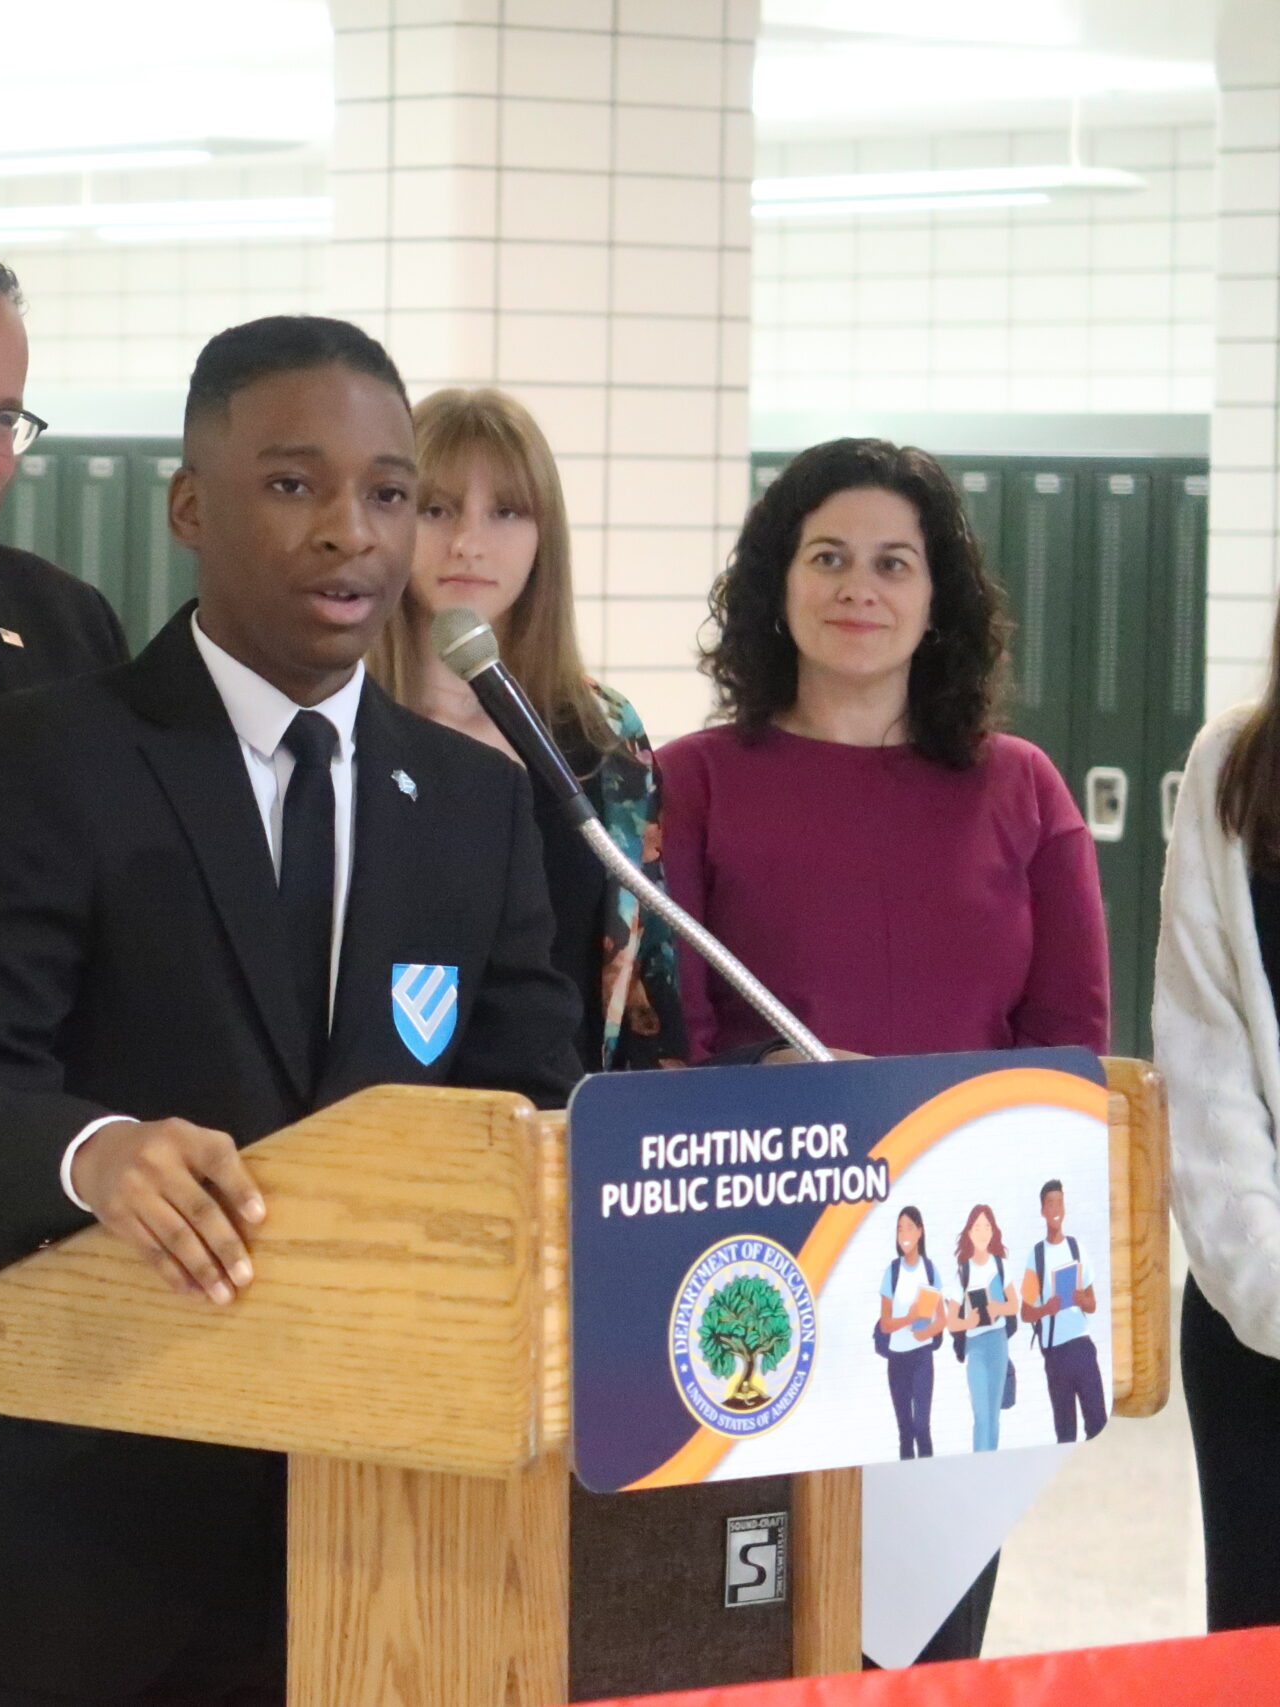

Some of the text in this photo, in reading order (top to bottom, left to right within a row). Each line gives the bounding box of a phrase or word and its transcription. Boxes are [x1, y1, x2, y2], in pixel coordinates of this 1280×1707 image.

[641, 1123, 848, 1170] FIGHTING FOR
[601, 1164, 887, 1218] PUBLIC EDUCATION
[674, 1242, 815, 1356] DEPARTMENT OF EDUCATION
[685, 1369, 807, 1431] UNITED STATES OF AMERICA
[730, 1518, 784, 1531] SOUND-CRAFT
